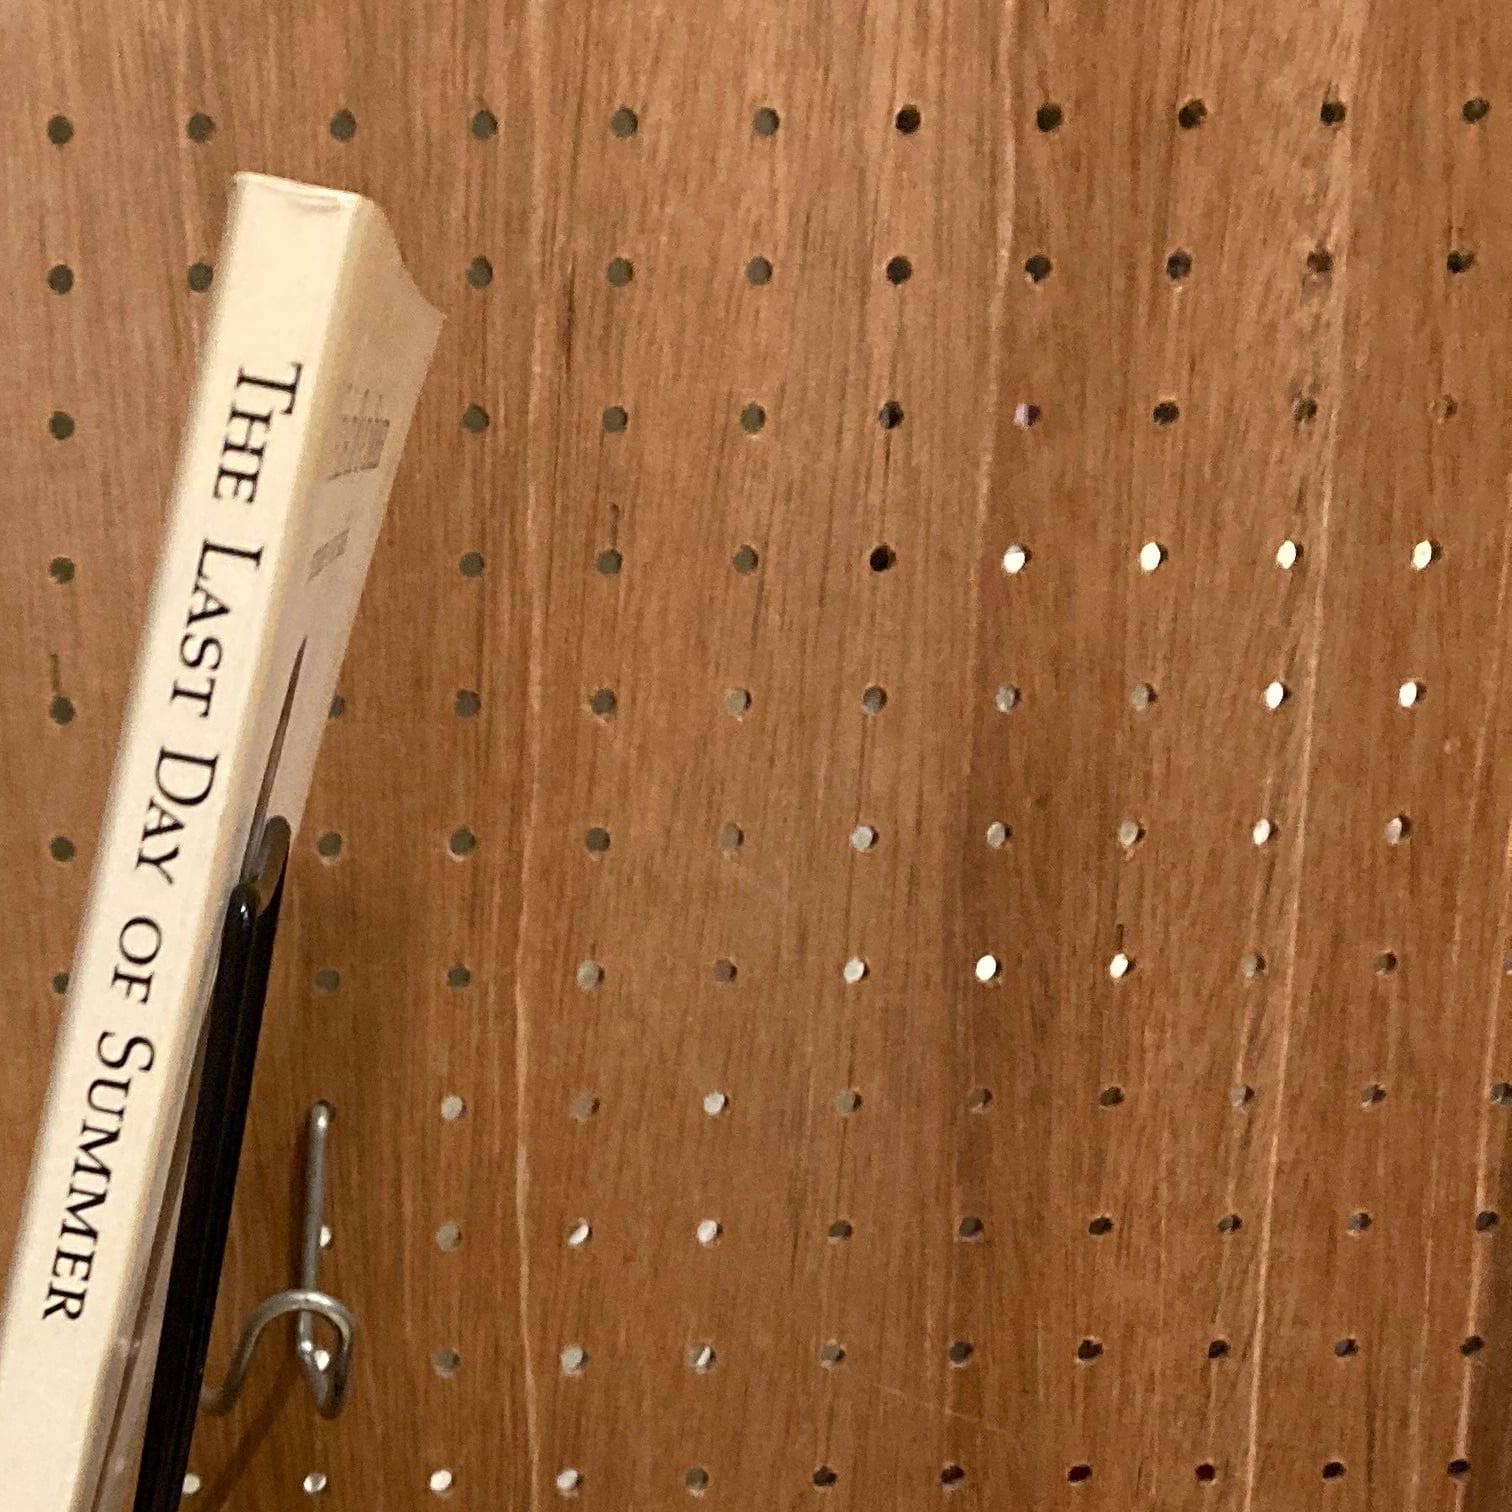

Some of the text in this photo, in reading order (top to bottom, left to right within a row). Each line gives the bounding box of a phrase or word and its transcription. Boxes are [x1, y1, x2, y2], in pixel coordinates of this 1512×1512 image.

[40, 360, 305, 1323] THE LAST DAY OF SUMMER
